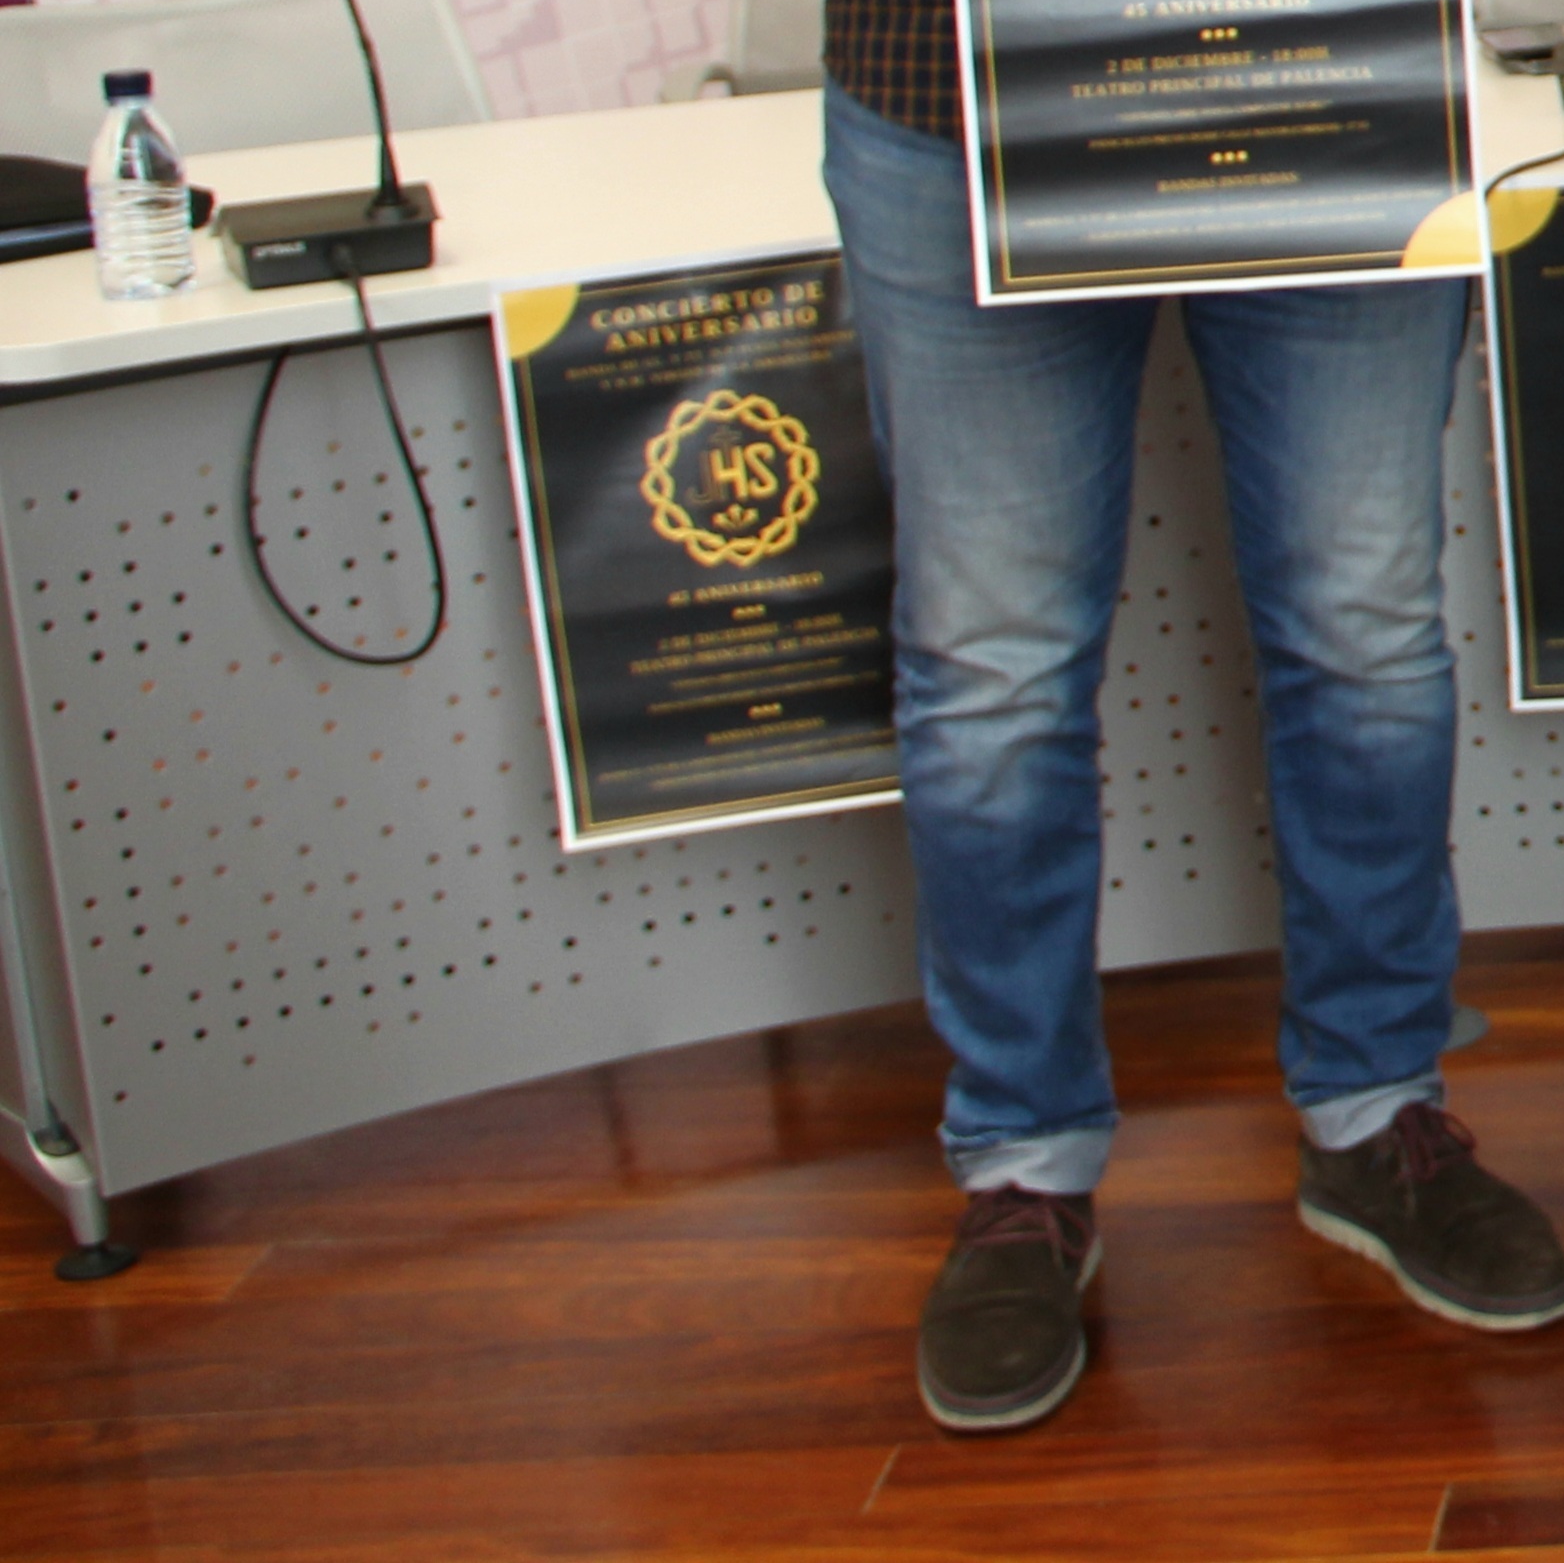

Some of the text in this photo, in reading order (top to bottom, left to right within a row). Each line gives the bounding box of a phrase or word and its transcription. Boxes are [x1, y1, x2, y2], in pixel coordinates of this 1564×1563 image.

[1123, 3, 1147, 19] 45
[1106, 60, 1117, 74] 2
[1120, 58, 1146, 72] DE
[1151, 50, 1254, 71] DICIEMBRE
[1071, 66, 1373, 98] TEATRO PRINCIPAL DE PALENCIA
[590, 281, 824, 331] CONCIERTO DE
[605, 305, 818, 354] ANIVERSARIO
